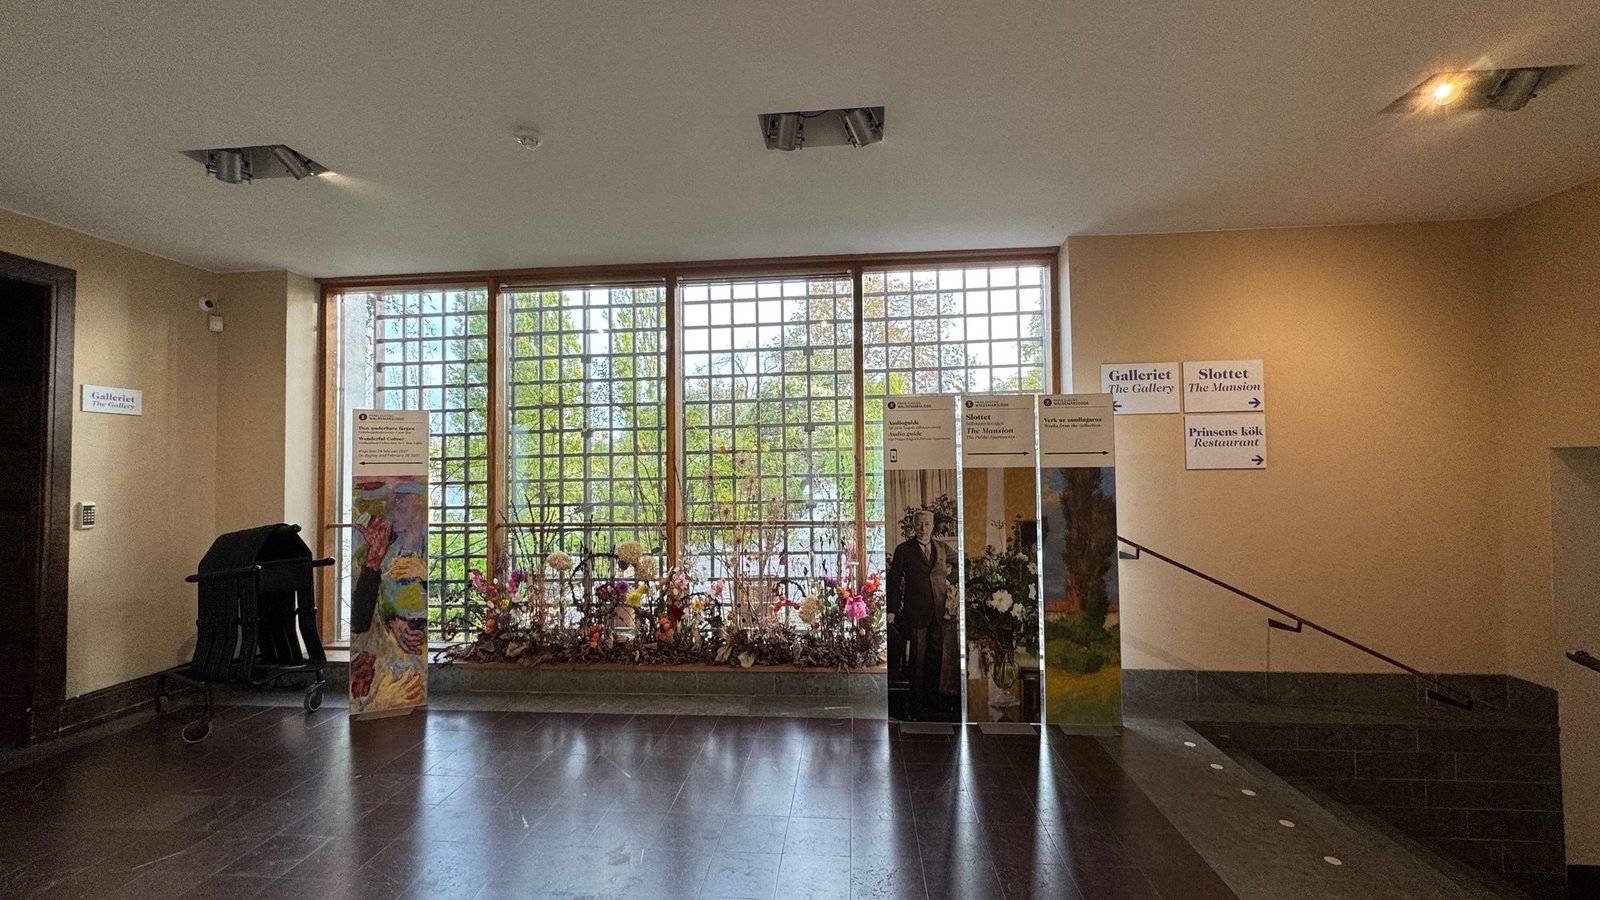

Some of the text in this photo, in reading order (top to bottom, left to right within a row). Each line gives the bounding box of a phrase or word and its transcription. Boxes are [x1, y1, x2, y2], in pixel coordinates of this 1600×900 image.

[1109, 369, 1172, 382] Galleriet
[1198, 368, 1249, 380] Slottet
[1109, 383, 1174, 395] The Gallery
[1188, 382, 1260, 393] The Mansion
[91, 391, 135, 403] Galleriet
[107, 401, 135, 411] Gallery
[1189, 426, 1264, 437] Prinsens kök
[1194, 437, 1260, 448] Restaurant
